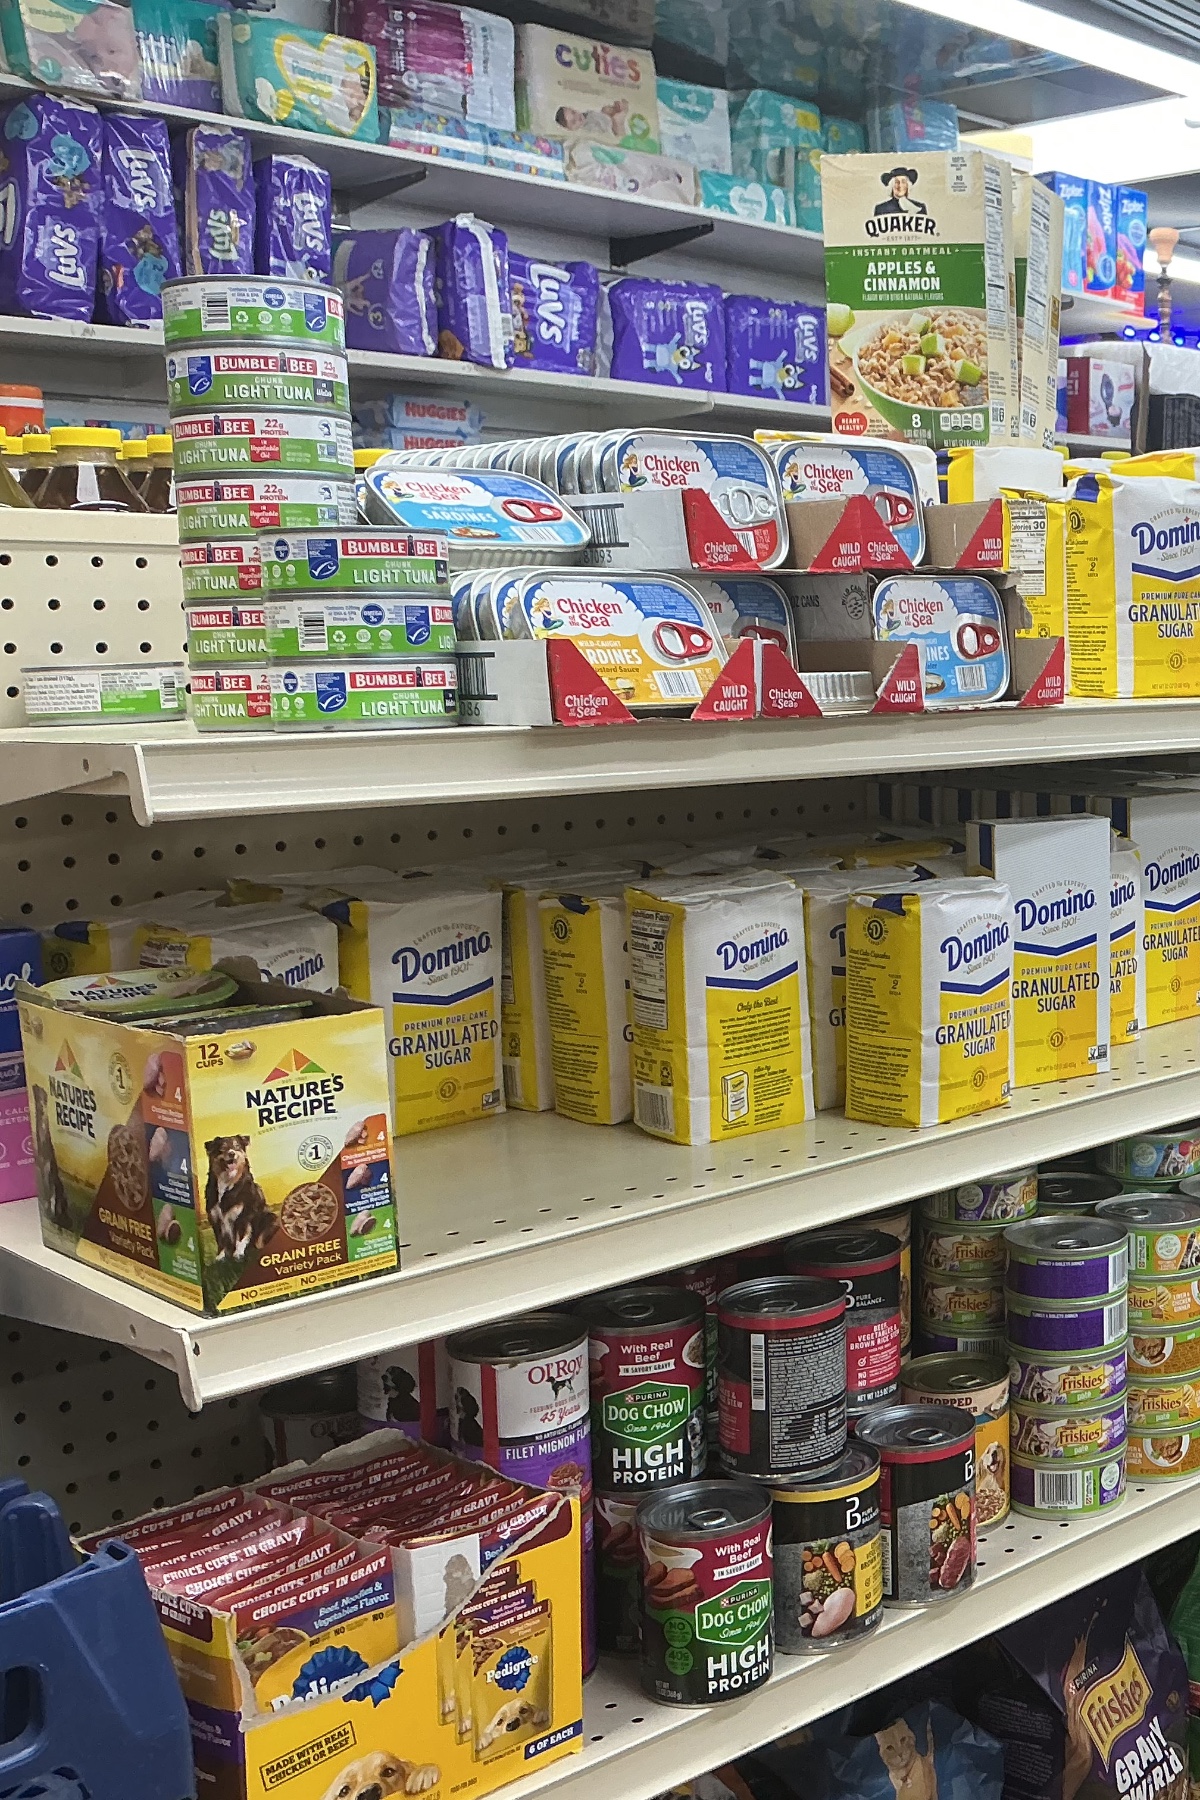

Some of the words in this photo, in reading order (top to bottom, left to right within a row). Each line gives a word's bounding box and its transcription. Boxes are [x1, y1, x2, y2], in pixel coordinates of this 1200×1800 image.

[555, 41, 641, 82] cuties
[117, 146, 157, 216] Luvs
[1059, 185, 1085, 200] Ziploc
[1099, 187, 1112, 235] Ziploc
[1122, 200, 1144, 214] Ziploc
[292, 191, 326, 253] Luvs
[865, 216, 941, 237] QUAKER
[207, 209, 238, 261] Luvs
[49, 222, 87, 290] Luvs
[852, 248, 898, 257] INSTANT
[902, 247, 952, 255] OATMEAL
[867, 261, 921, 275] APPLES
[925, 260, 936, 274] &
[864, 276, 940, 291] CINNAMON
[529, 263, 571, 345] Luvs
[220, 357, 277, 370] BUMBLE
[290, 359, 313, 372] BEE
[224, 385, 270, 398] LIGHT
[273, 386, 312, 400] TUNA
[405, 402, 467, 421] HUGGIES
[179, 451, 209, 464] LIGHT
[210, 448, 249, 463] TUNA
[644, 455, 700, 473] Chicken
[662, 472, 687, 486] Sea
[804, 464, 854, 482] Chicken
[422, 510, 498, 523] SARDINES
[347, 541, 406, 554] BUMBLE
[416, 542, 436, 555] BEE
[704, 543, 738, 554] Chicken
[839, 542, 860, 555] WILD
[832, 555, 861, 567] CAUGHT
[353, 569, 400, 583] LIGHT
[402, 570, 436, 583] TUNA
[1142, 592, 1172, 600] PREMIUM
[1174, 591, 1189, 599] PURE
[557, 599, 623, 615] Chicken
[899, 597, 943, 615] Chicken
[192, 613, 230, 626] BUMBLE
[581, 614, 611, 628] Sea
[912, 612, 933, 626] Sea
[1158, 623, 1194, 638] SUGAR
[356, 672, 415, 687] BUMBLE
[424, 673, 445, 685] BEE
[896, 680, 916, 692] WILD
[1045, 676, 1061, 687] WILD
[722, 685, 747, 699] WILD
[890, 692, 916, 703] CAUGHT
[362, 702, 406, 716] LIGHT
[409, 700, 443, 714] TUNA
[713, 699, 747, 712] CAUGHT
[1014, 888, 1097, 932] Domino
[652, 940, 663, 952] 30
[716, 927, 789, 971] Domino
[940, 921, 1010, 972] Domino
[392, 930, 492, 983] Domino
[1021, 965, 1053, 975] PREMIUM
[1055, 963, 1072, 972] PURE
[1075, 961, 1091, 970] CANE
[1011, 972, 1100, 999] GRANULATED
[389, 1019, 499, 1056] GRANULATED
[198, 1043, 220, 1061] 12
[963, 1036, 996, 1058] SUGAR
[196, 1058, 224, 1069] CUPS
[425, 1047, 471, 1070] SUGAR
[246, 1073, 344, 1109] NATURE'S
[55, 1102, 96, 1139] RECIPE
[258, 1095, 338, 1128] RECIPE
[98, 1207, 128, 1230] GRAIN
[129, 1216, 153, 1241] FREE
[260, 1248, 306, 1267] GRAIN
[308, 1238, 341, 1256] FREE
[275, 1260, 314, 1276] Variety
[316, 1252, 342, 1266] Pack
[300, 1275, 317, 1286] NO
[621, 1344, 647, 1354] With
[651, 1339, 673, 1350] Real
[635, 1352, 660, 1363] Beef
[1062, 1375, 1102, 1391] Friskies
[608, 1405, 638, 1421] DOG
[643, 1398, 685, 1419] CHOW
[1142, 1398, 1181, 1410] Friskies
[540, 1412, 556, 1423] 45
[558, 1404, 580, 1426] Years
[1060, 1430, 1100, 1445] Friskies
[506, 1446, 534, 1460] FILET
[538, 1437, 575, 1455] MIGNON
[613, 1439, 684, 1469] HIGH
[613, 1462, 684, 1484] PROTEIN
[715, 1544, 741, 1557] With
[743, 1533, 762, 1549] Real
[730, 1549, 752, 1564] Beef
[252, 1595, 297, 1621] CHOICE
[300, 1583, 330, 1603] CUTS
[336, 1576, 349, 1588] IN
[350, 1557, 387, 1583] GRAVY
[313, 1605, 359, 1631] Vegetables
[359, 1592, 390, 1610] Flavor
[707, 1635, 770, 1678] HIGH
[485, 1654, 538, 1683] Pedigree
[708, 1659, 770, 1694] PROTEIN
[529, 1744, 535, 1753] 6
[537, 1739, 548, 1750] OF
[549, 1727, 574, 1746] EACH
[265, 1755, 295, 1776] MADE
[296, 1742, 323, 1762] WITH
[324, 1728, 349, 1747] REAL
[268, 1758, 311, 1784] CHICKEN
[313, 1751, 326, 1765] OR
[327, 1736, 350, 1755] BEEF
[1115, 1716, 1168, 1794] GRAVY
